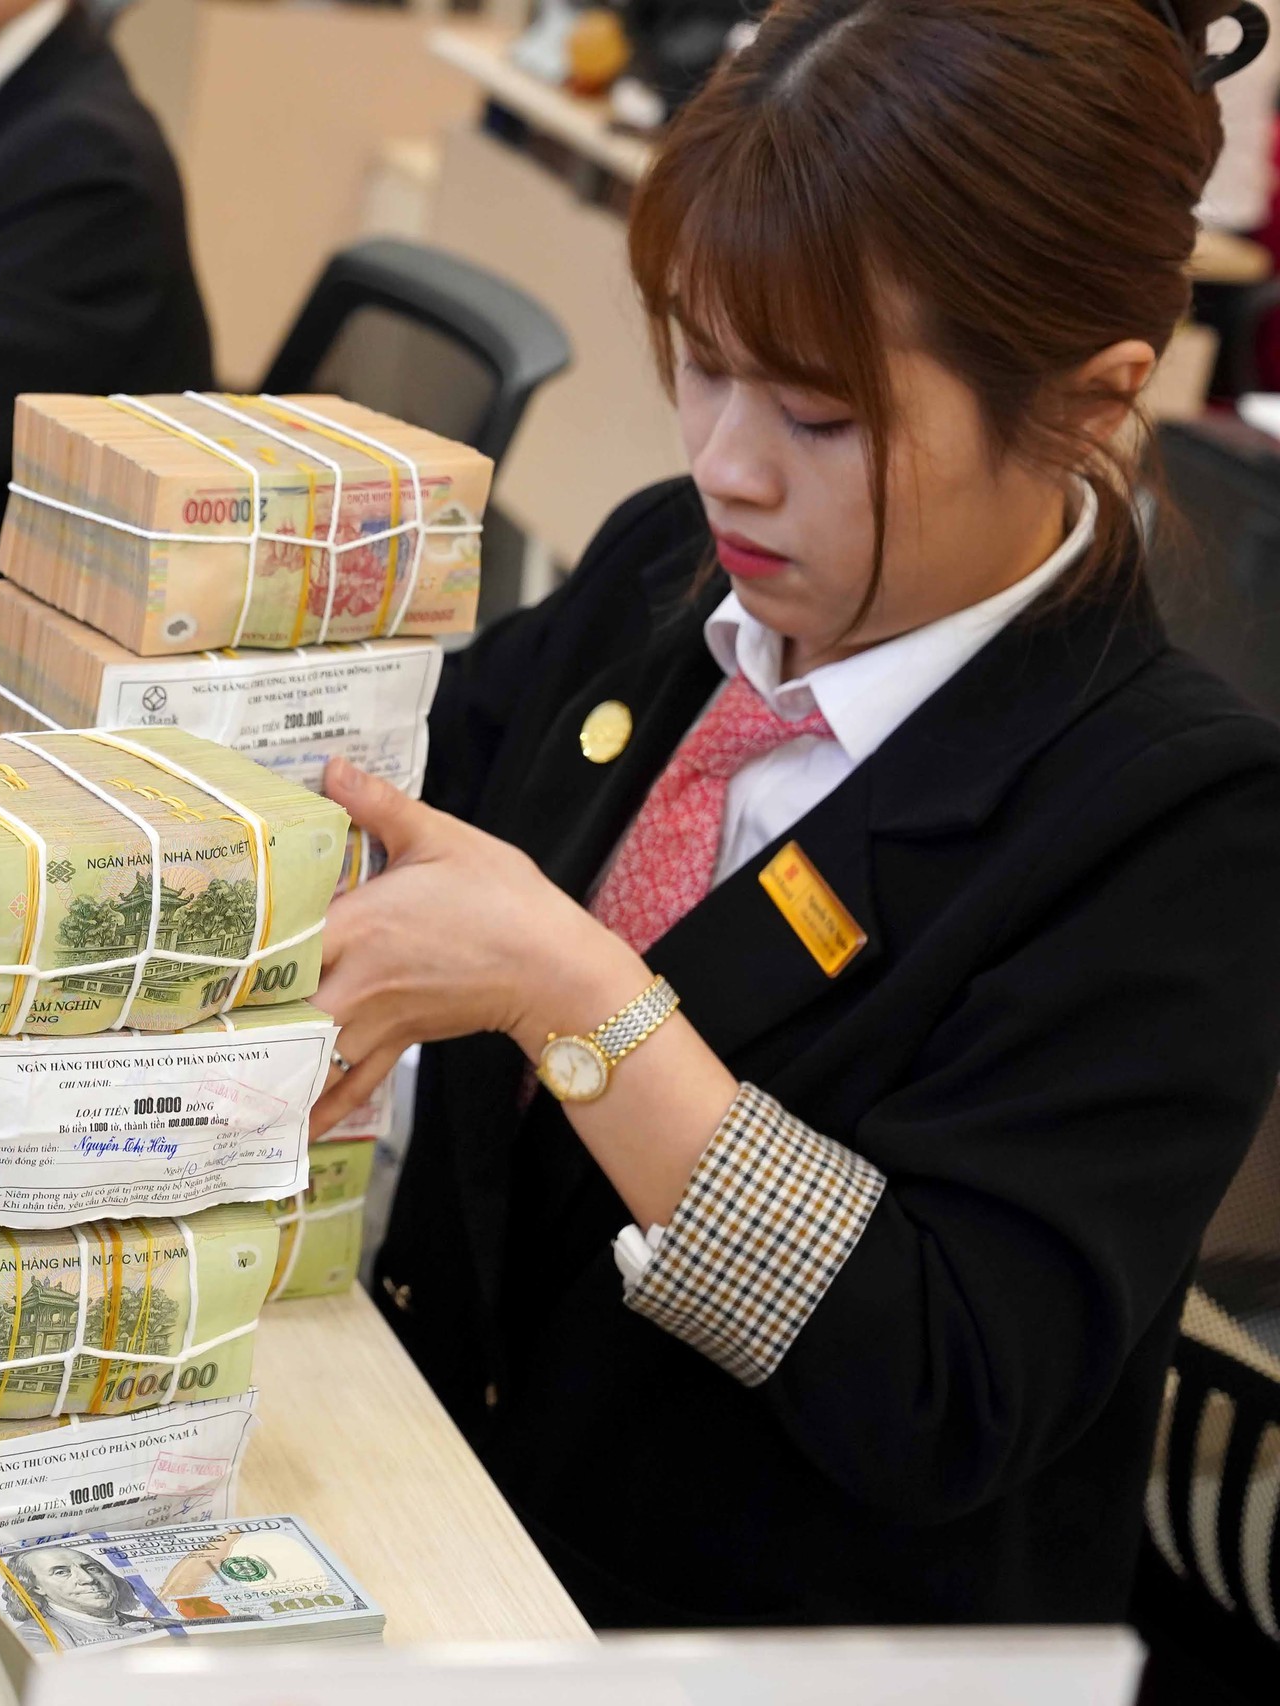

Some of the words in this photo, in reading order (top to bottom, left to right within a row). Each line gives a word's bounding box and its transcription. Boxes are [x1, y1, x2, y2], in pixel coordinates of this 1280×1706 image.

[284, 710, 323, 730] 200.000
[87, 855, 123, 869] NGÂN
[164, 848, 192, 862] NHÀ
[196, 844, 228, 860] NƯỚC
[230, 840, 249, 855] VIỆT
[55, 999, 102, 1012] NGHÌN
[25, 1014, 59, 1024] ỒNG
[17, 1061, 47, 1073] NGÂN
[51, 1059, 82, 1072] HÀNG
[85, 1058, 131, 1070] THƯƠNG
[134, 1057, 154, 1069] MẠI
[157, 1054, 173, 1067] CỔ
[177, 1053, 204, 1065] PHẦN
[207, 1052, 236, 1064] ĐÔNG
[238, 1052, 261, 1061] NAM
[262, 1050, 269, 1060] Á
[59, 1080, 76, 1090] CHI
[78, 1078, 112, 1089] NHÁNH:
[75, 1108, 102, 1119] LOẠI
[104, 1104, 130, 1116] TIỀN
[133, 1096, 182, 1115] 100.000
[186, 1101, 214, 1112] ĐỒNG
[59, 1124, 70, 1134] Bó
[72, 1122, 88, 1133] tiền
[89, 1122, 109, 1132] 1.000
[110, 1121, 121, 1133] tờ,
[124, 1117, 148, 1130] thành
[150, 1116, 166, 1129] tiền
[168, 1116, 209, 1128] 100.000.000
[210, 1115, 229, 1127] đồng
[18, 1141, 38, 1153] kiểm
[41, 1141, 59, 1153] tiền:
[74, 1135, 120, 1157] Nguyễn
[122, 1137, 144, 1157] Thị
[147, 1136, 180, 1161] Hằng
[15, 1156, 37, 1167] đóng
[39, 1156, 55, 1167] gói:
[3, 1200, 20, 1209] Khi
[22, 1201, 45, 1212] nhận
[47, 1199, 66, 1211] tiền,
[68, 1200, 86, 1211] yêu
[88, 1196, 100, 1207] cầu
[101, 1194, 129, 1205] Khách
[130, 1191, 148, 1202] hàng
[151, 1190, 170, 1201] đếm
[172, 1188, 182, 1200] tại
[183, 1186, 200, 1199] quầy
[202, 1183, 212, 1194] chi
[5, 1190, 30, 1199] Niêm
[32, 1191, 61, 1202] phong
[63, 1191, 79, 1202] này
[95, 1187, 105, 1197] có
[107, 1186, 120, 1197] giá
[122, 1185, 132, 1196] trị
[133, 1183, 154, 1195] trong
[157, 1181, 170, 1192] nội
[172, 1181, 182, 1191] bộ
[184, 1177, 203, 1190] Ngân
[22, 1257, 59, 1271] HÀNG
[63, 1256, 80, 1268] NH
[164, 1247, 189, 1259] NAM
[103, 1362, 219, 1403] 100.000
[21, 1453, 67, 1468] THƯƠNG
[69, 1449, 89, 1462] MẠI
[91, 1443, 107, 1456] CỔ
[109, 1440, 137, 1454] PHẦN
[139, 1434, 167, 1449] ĐÔNG
[169, 1430, 190, 1443] NAM
[191, 1426, 198, 1437] Á
[0, 1480, 15, 1491] CHI
[16, 1474, 48, 1486] NHÁNH:
[17, 1503, 42, 1515] LOẠI
[44, 1498, 67, 1511] TIỀN
[69, 1481, 114, 1506] 100.000
[118, 1482, 145, 1497] ĐỒNG
[0, 1518, 9, 1529] Bó
[11, 1514, 25, 1526] tiền
[60, 1507, 83, 1519] thành
[225, 1520, 280, 1535] 100
[269, 1594, 345, 1614] 100
